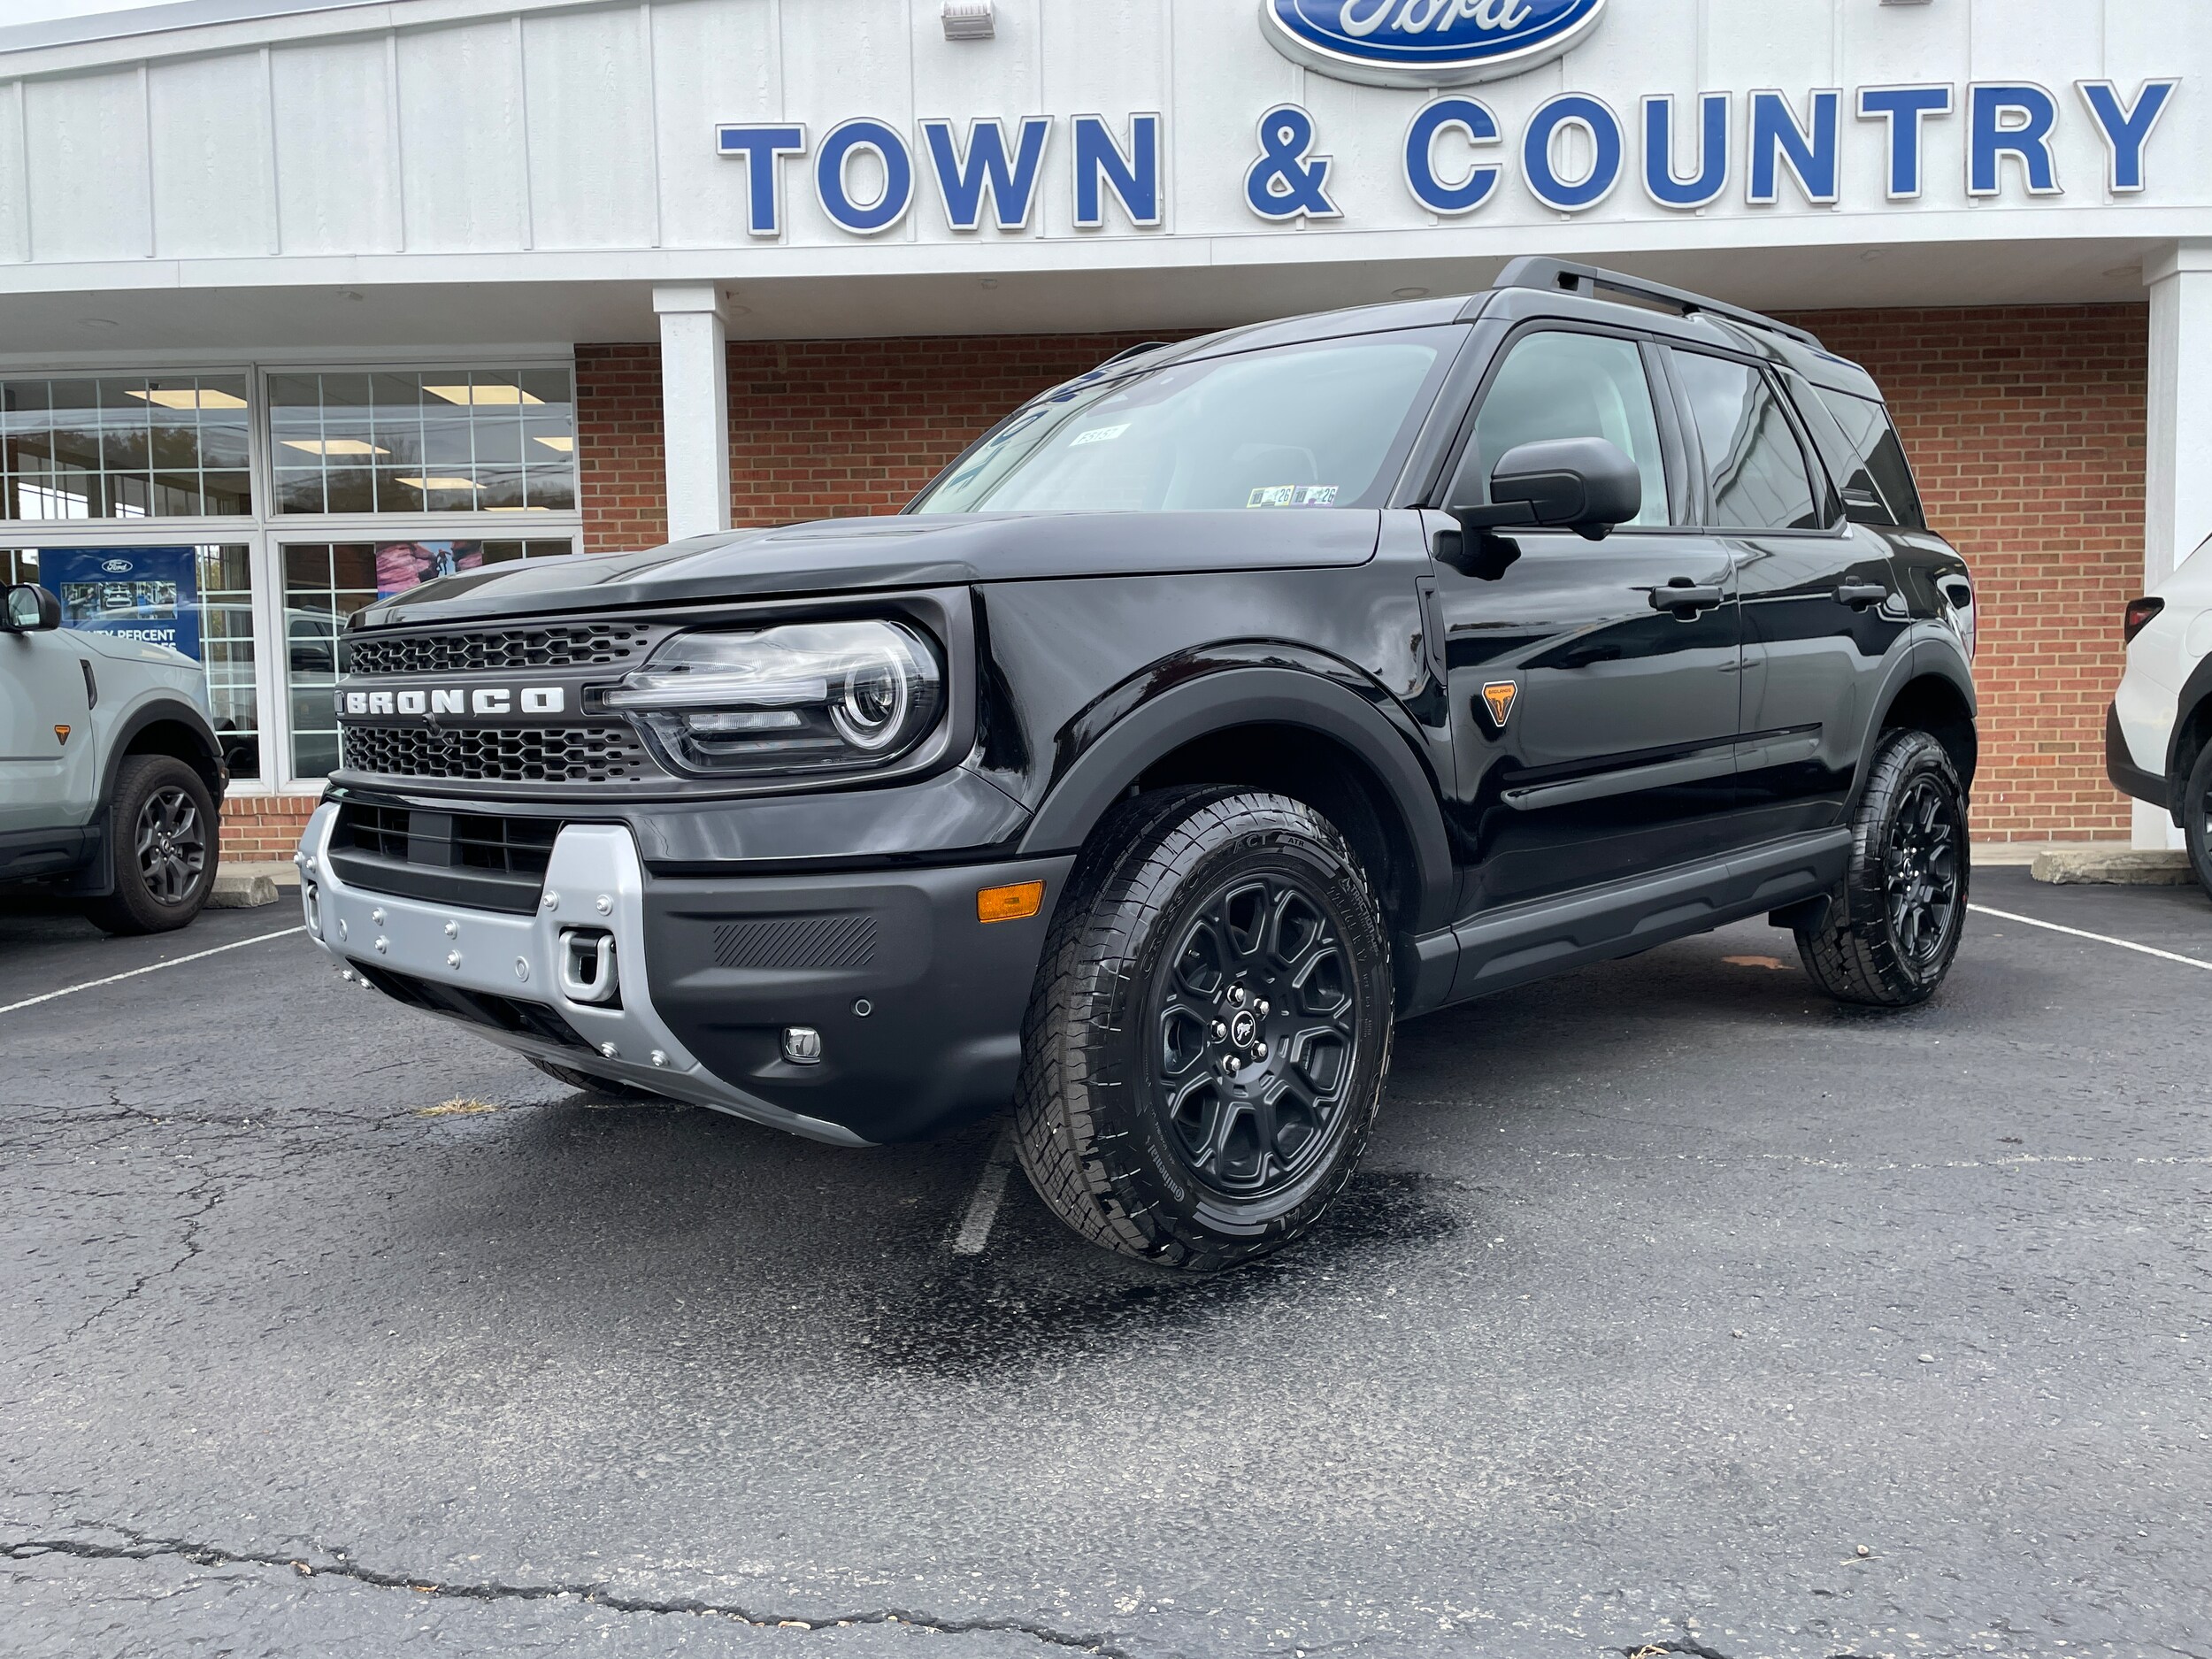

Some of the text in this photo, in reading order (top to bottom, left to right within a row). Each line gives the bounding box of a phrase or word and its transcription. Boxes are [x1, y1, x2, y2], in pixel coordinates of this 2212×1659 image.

[715, 77, 2183, 237] TOWN & COUNTRY
[1279, 488, 1292, 503] 26
[1322, 488, 1336, 503] 26
[107, 561, 127, 572] Ford
[117, 629, 176, 642] PERCENT
[346, 687, 565, 715] BRONCO
[1288, 837, 1305, 848] ATR
[1350, 883, 1375, 934] TRACTION
[1147, 1144, 1185, 1202] Continental
